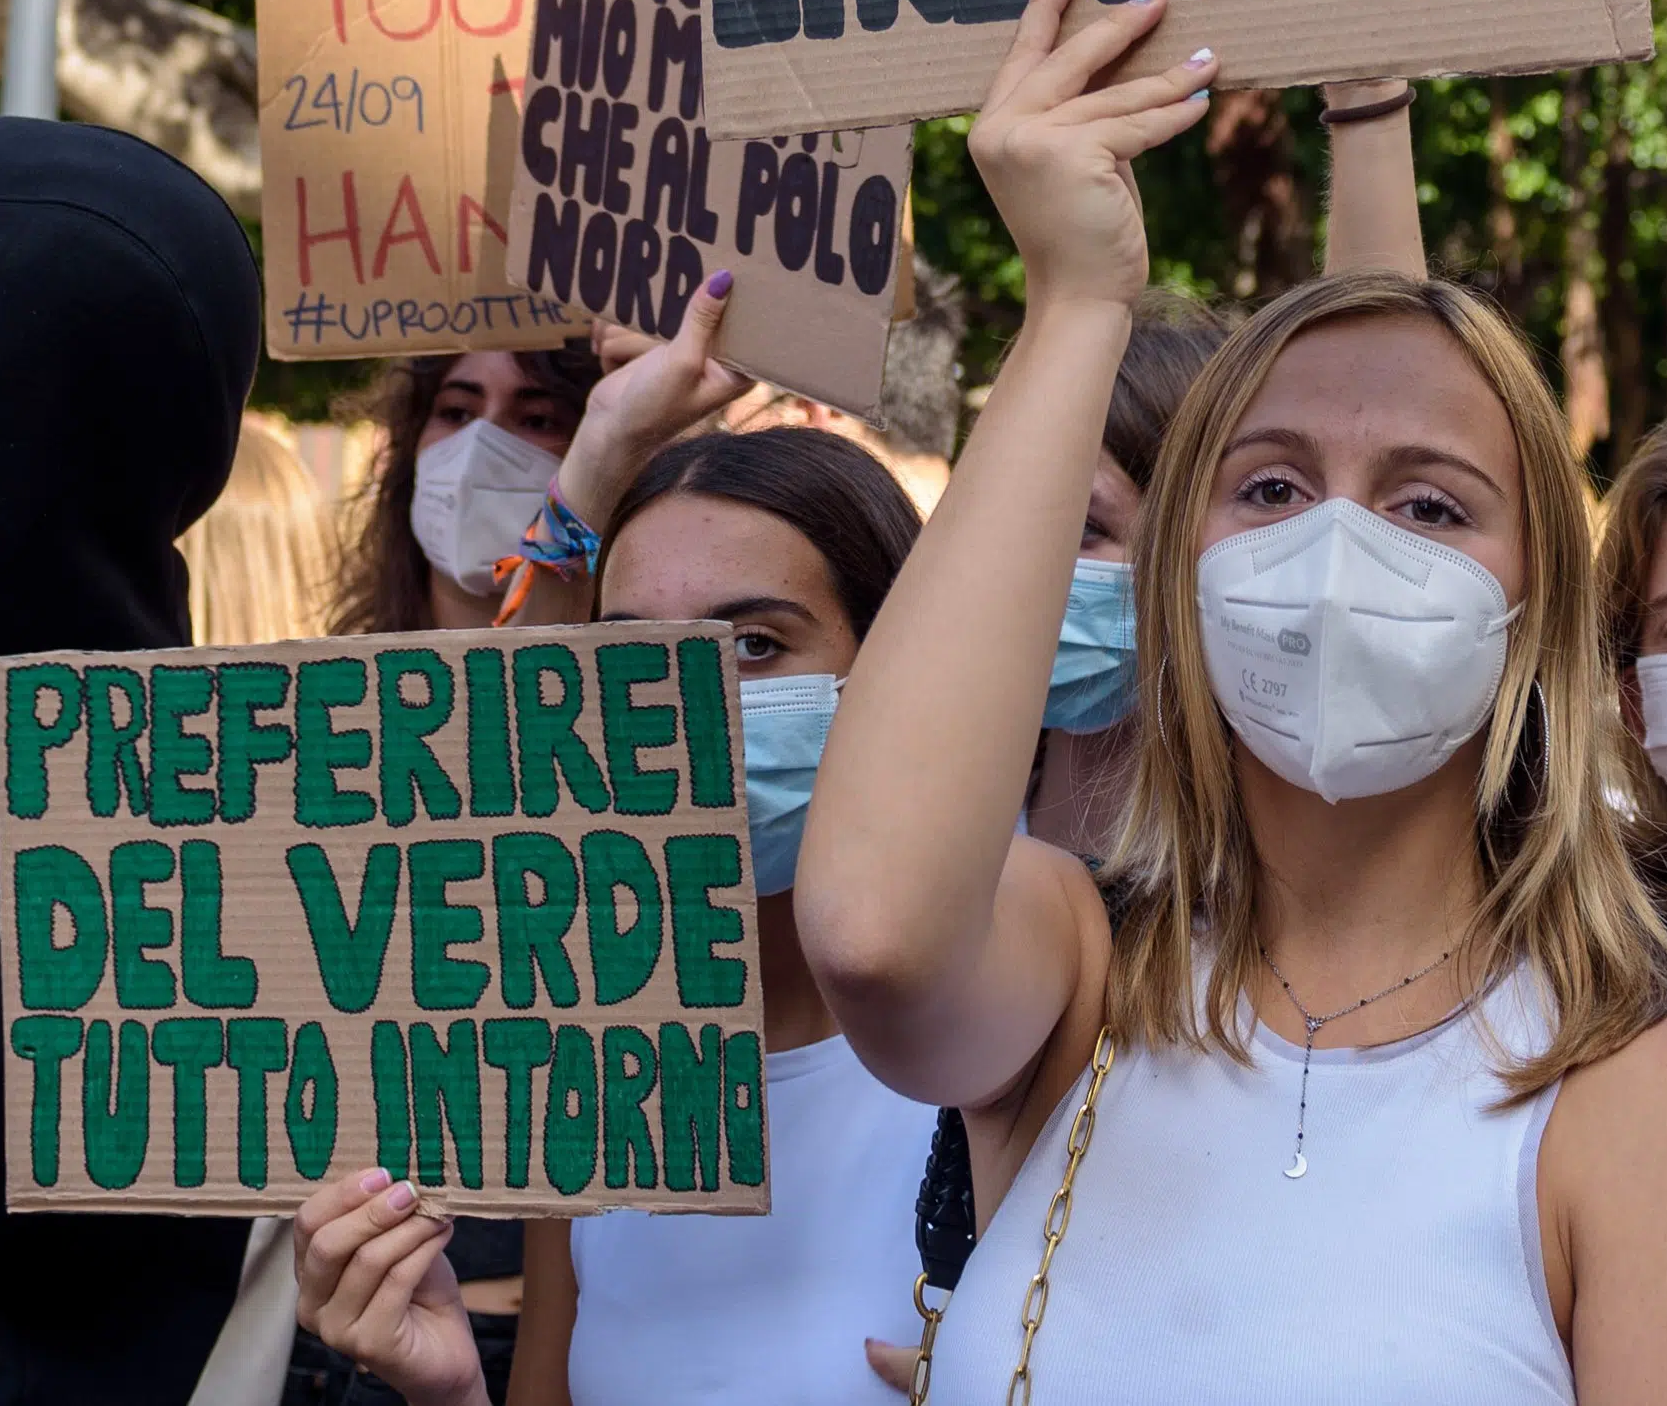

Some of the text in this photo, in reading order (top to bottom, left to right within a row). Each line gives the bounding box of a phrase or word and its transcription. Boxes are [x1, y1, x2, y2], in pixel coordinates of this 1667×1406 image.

[282, 68, 425, 135] 24/09
[521, 85, 897, 296] CHE AL POLO
[527, 192, 704, 340] NORD
[6, 636, 736, 828] PREFERIREI
[14, 829, 749, 1014] DEL VERDE
[10, 1014, 765, 1194] TUTTO INTORNO
